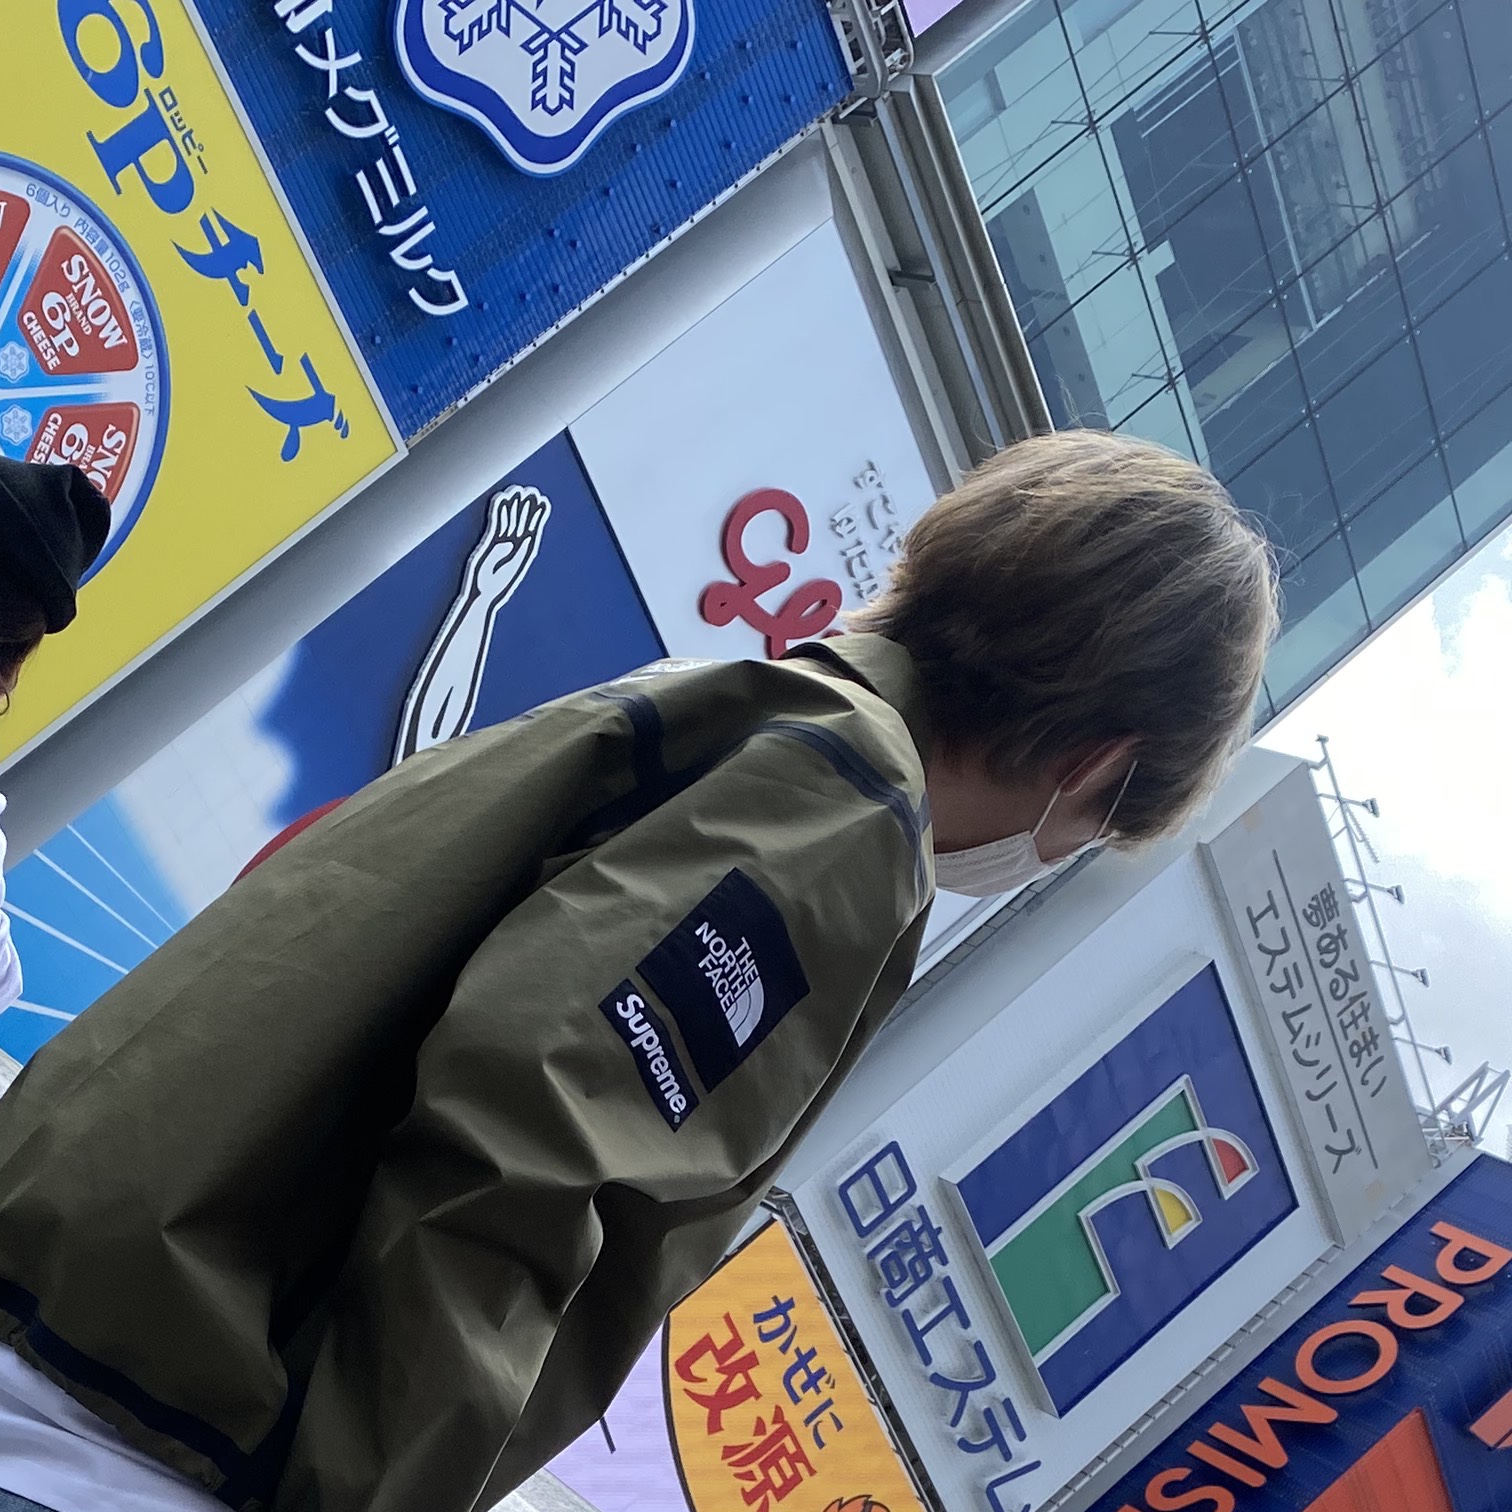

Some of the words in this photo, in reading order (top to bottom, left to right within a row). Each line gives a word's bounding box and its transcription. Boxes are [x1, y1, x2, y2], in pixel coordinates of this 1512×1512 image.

[24, 182, 72, 218] 6個入り
[57, 0, 350, 463] 6Pチーズ
[42, 291, 81, 359] 6P
[61, 253, 127, 350] SNOW
[66, 293, 92, 335] BRAND
[22, 311, 61, 371] CHEESE
[694, 921, 749, 997] NORTH
[698, 954, 737, 1013] FACE
[734, 936, 759, 985] THE
[1302, 881, 1387, 1098] 夢ある住まい
[616, 993, 687, 1113] Supreme
[1246, 889, 1362, 1174] エステムシリーズ
[752, 1295, 843, 1450] かぜに
